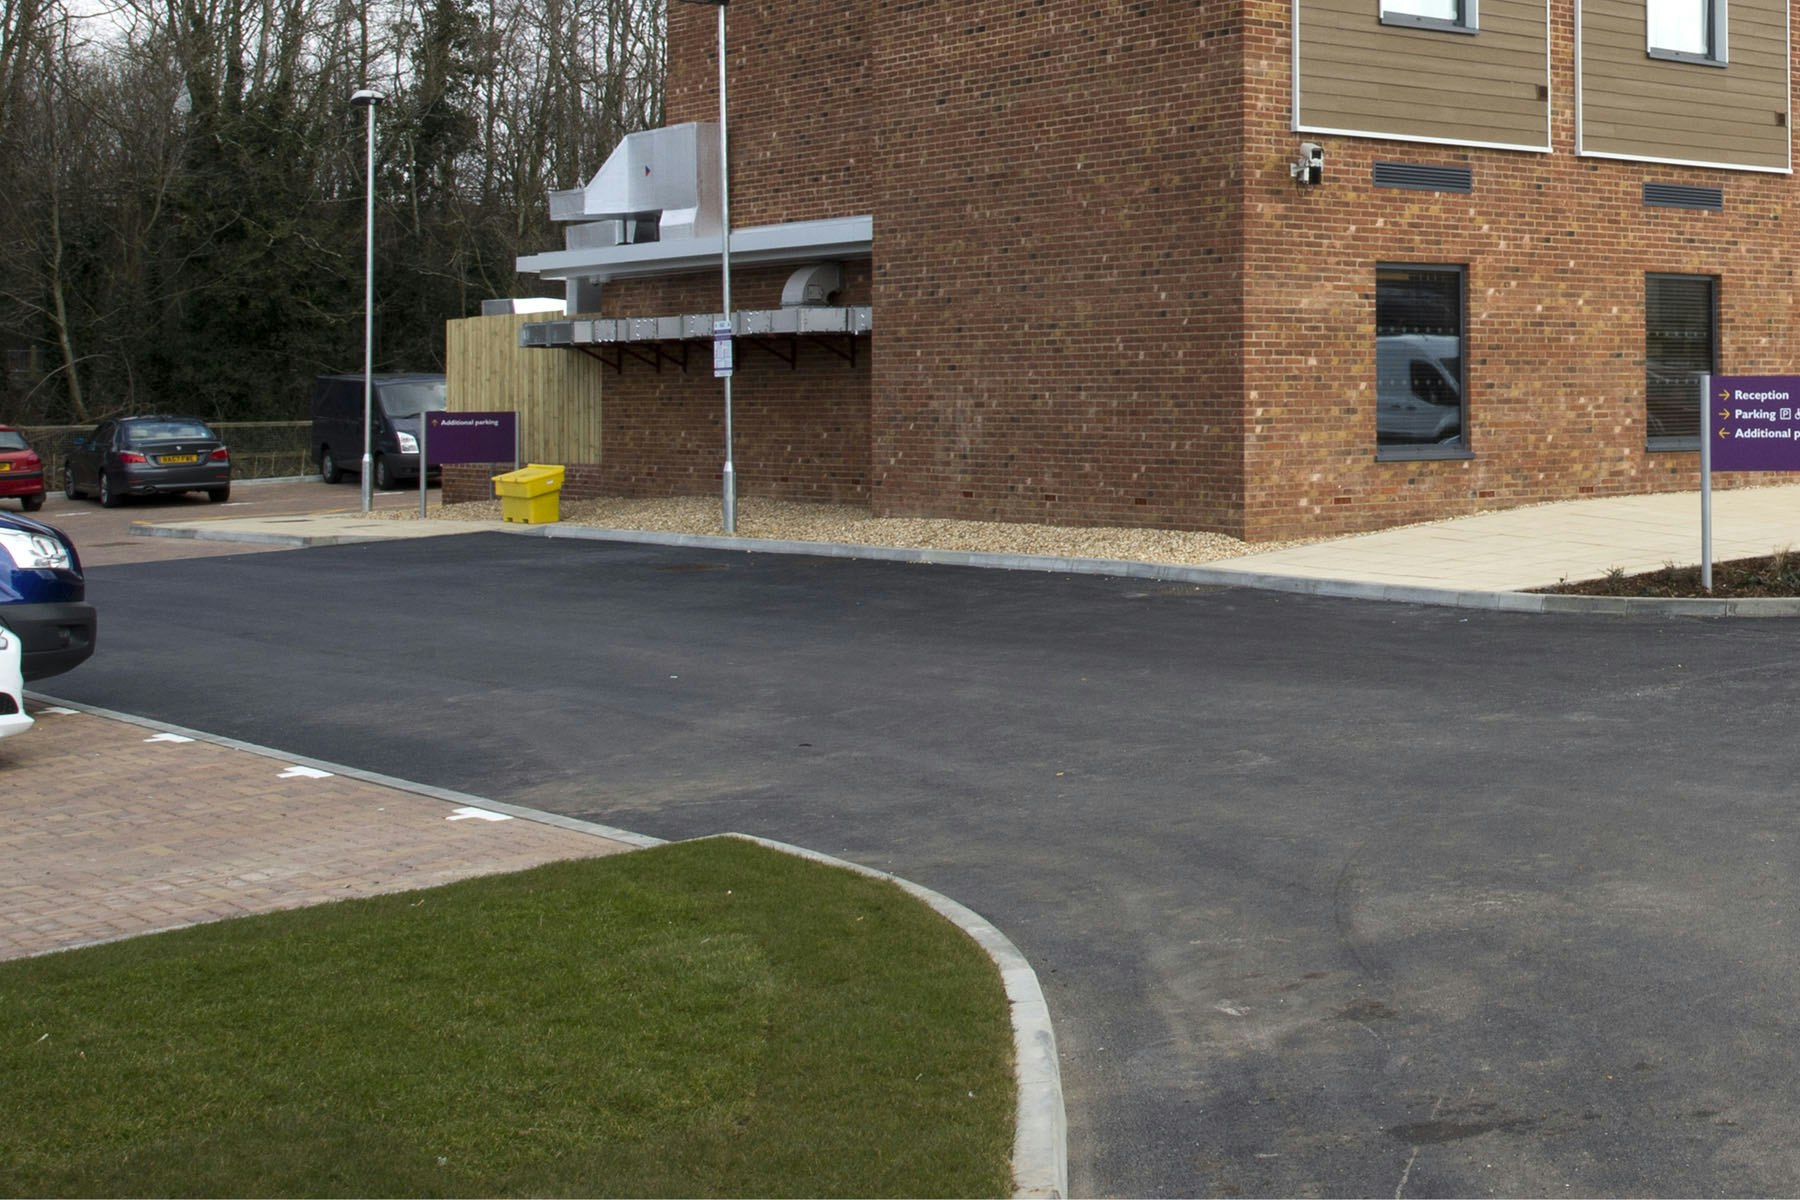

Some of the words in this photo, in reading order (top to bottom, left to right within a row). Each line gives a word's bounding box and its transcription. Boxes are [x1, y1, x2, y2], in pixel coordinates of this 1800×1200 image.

[1734, 390, 1789, 402] Reception
[1734, 409, 1777, 421] Parking
[475, 419, 499, 427] parking
[1734, 428, 1791, 439] Additional
